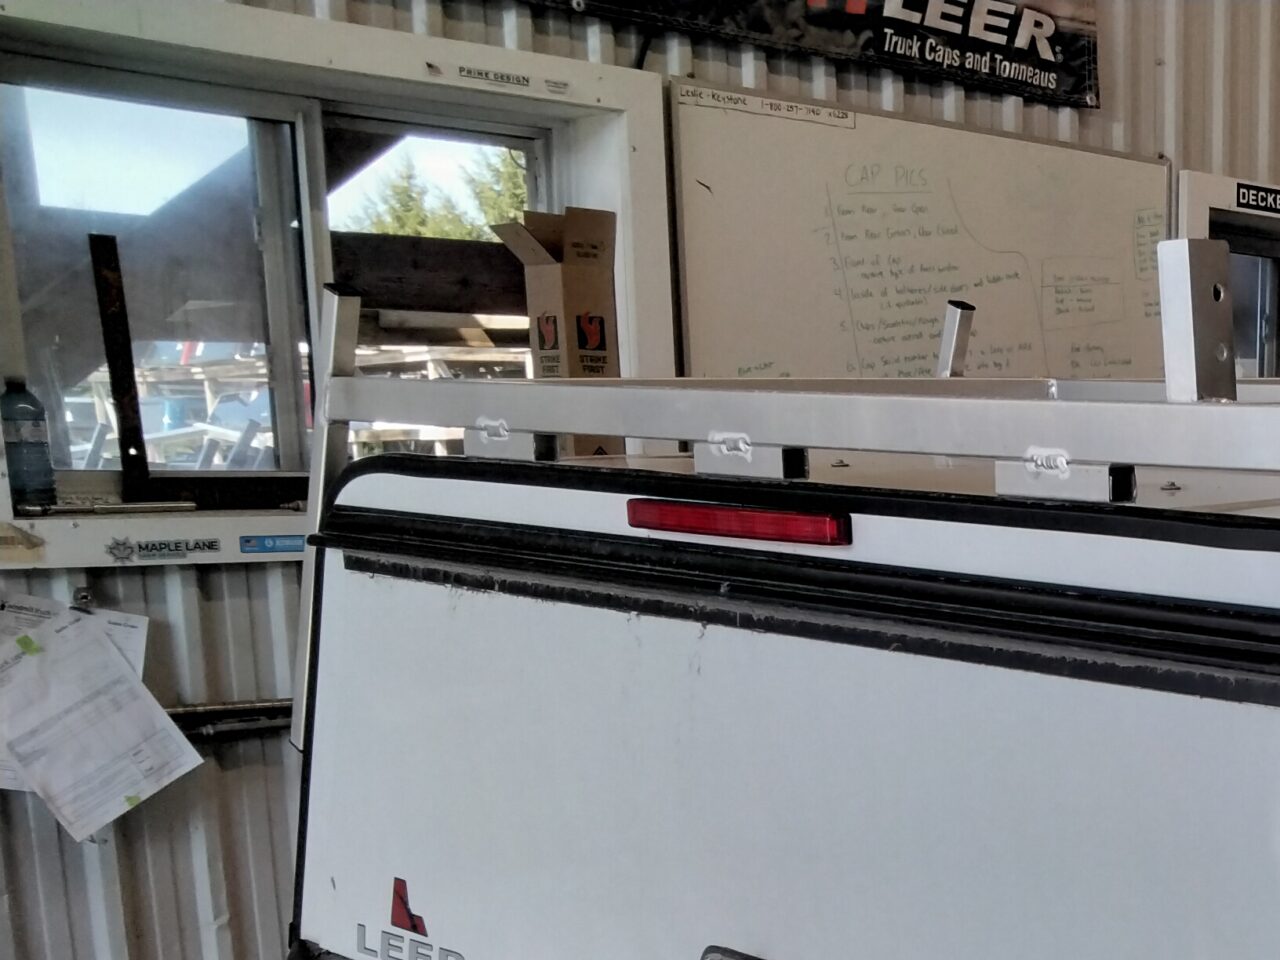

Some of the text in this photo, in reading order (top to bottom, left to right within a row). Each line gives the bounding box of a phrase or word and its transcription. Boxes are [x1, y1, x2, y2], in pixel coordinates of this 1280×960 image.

[883, 28, 1057, 90] Truck Caps and Tonneaus
[845, 163, 928, 188] CAP PICS
[579, 354, 608, 364] STRIKE
[138, 540, 219, 553] MAPLE LANE
